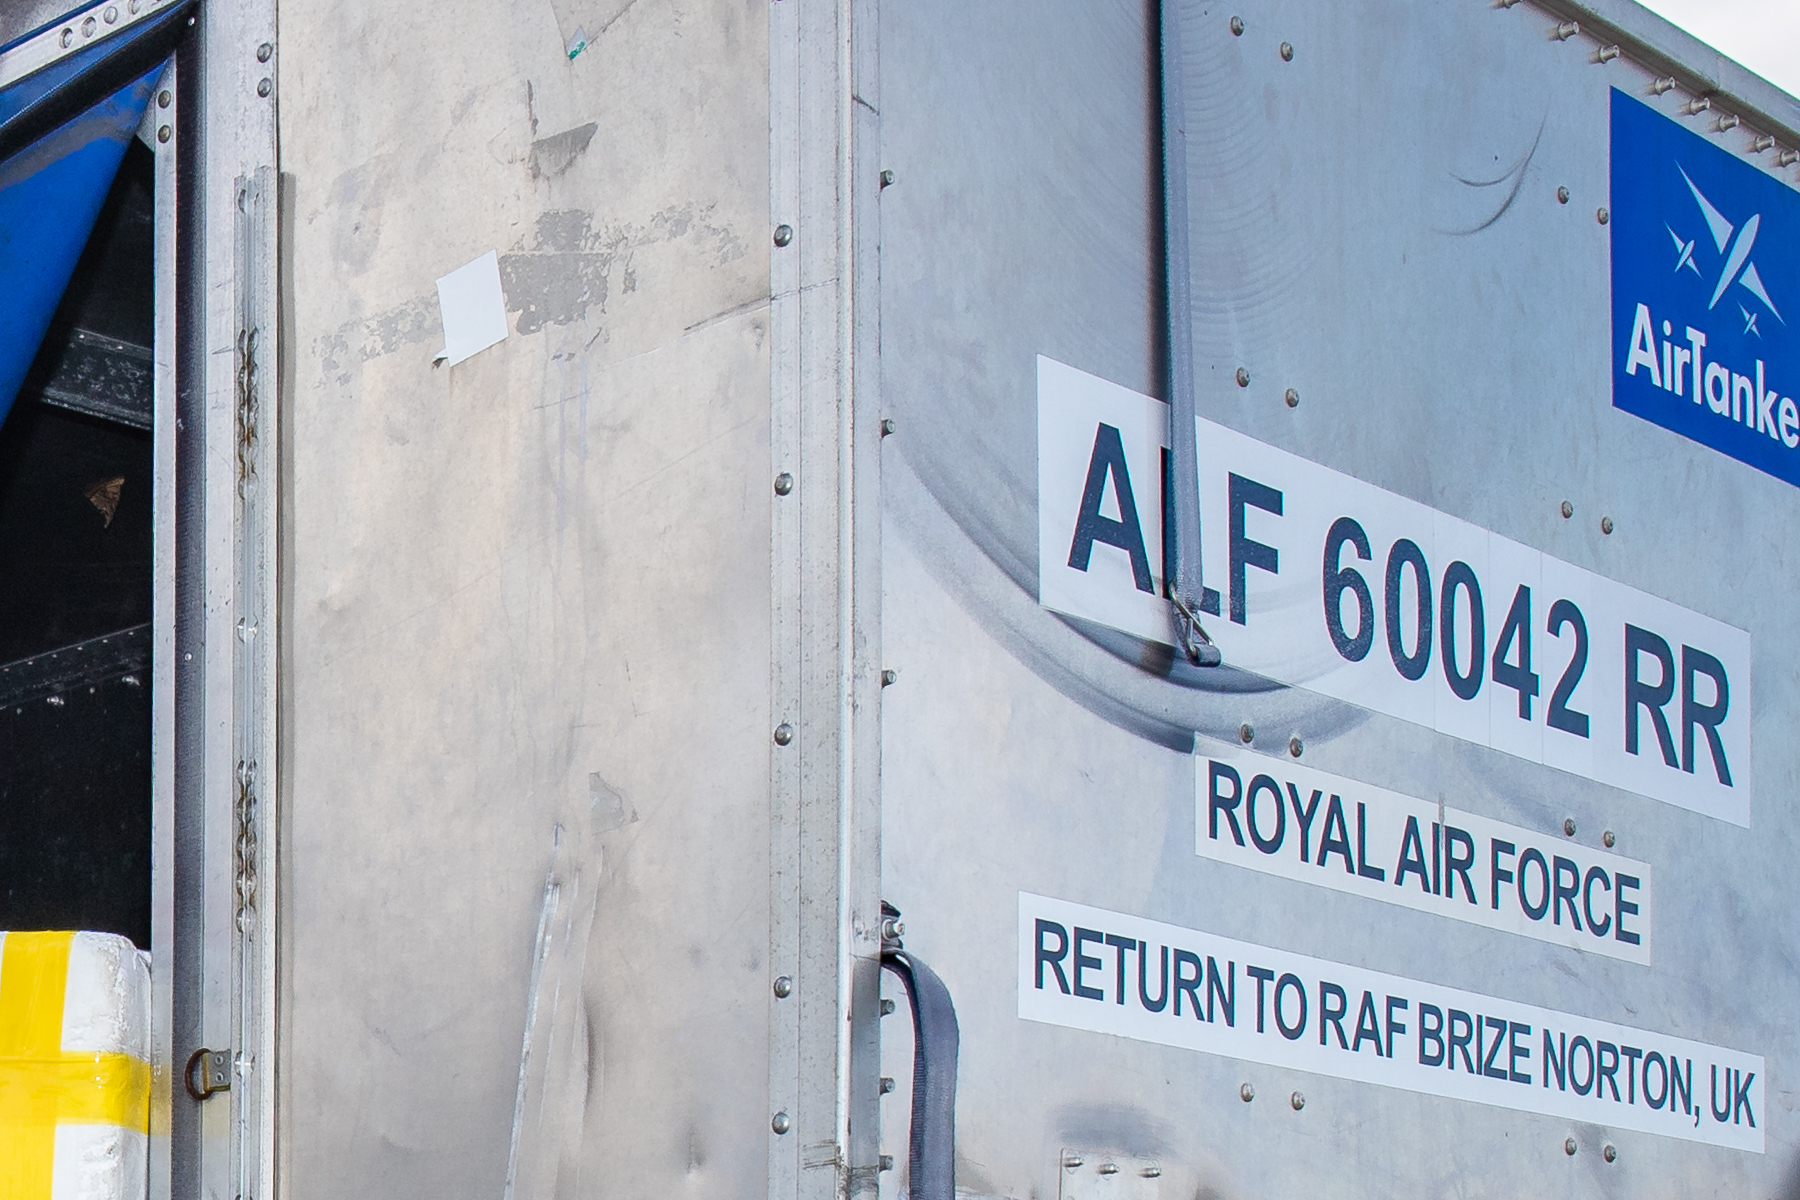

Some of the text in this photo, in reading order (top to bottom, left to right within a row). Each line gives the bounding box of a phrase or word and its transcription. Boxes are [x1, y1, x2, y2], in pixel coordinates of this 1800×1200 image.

[1625, 302, 1800, 449] AirTanke
[1322, 516, 1591, 740] 60042
[1624, 622, 1733, 788] RR
[1208, 760, 1641, 946] ROYAL AIR FORCE
[1033, 917, 1756, 1130] RETURN TO RAF BRIZE NORTON, UK
